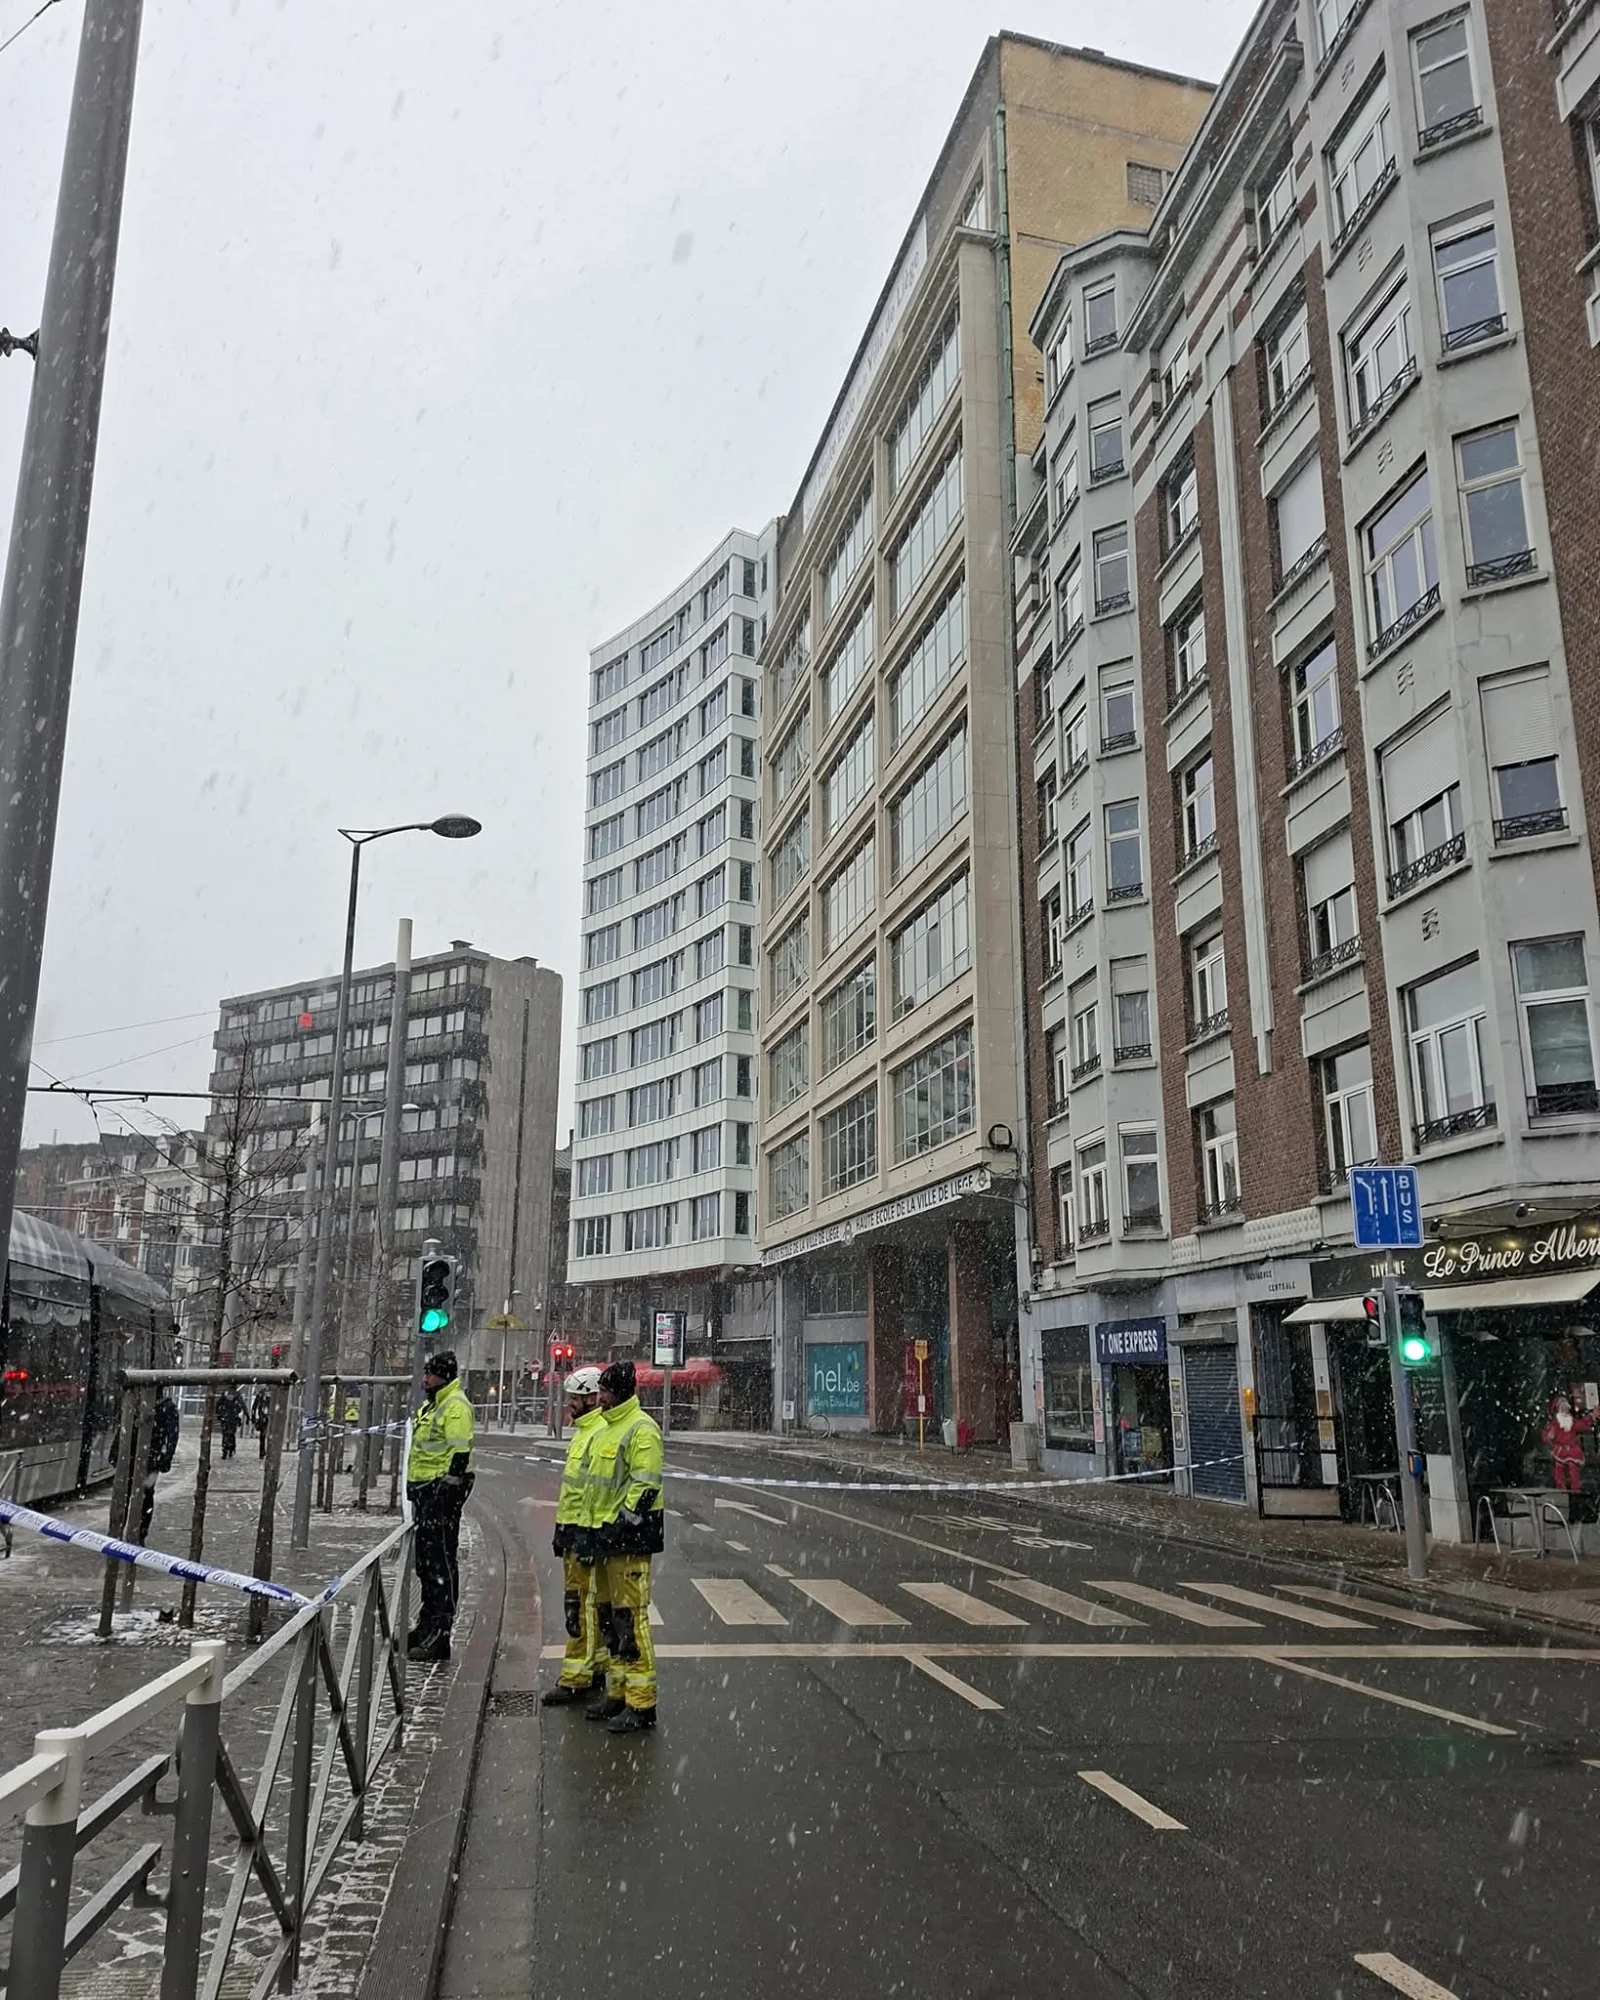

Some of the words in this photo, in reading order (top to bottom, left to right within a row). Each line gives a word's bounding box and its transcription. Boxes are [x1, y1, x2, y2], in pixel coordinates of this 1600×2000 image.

[856, 1211, 874, 1229] HAUTE
[876, 1204, 895, 1225] ECOLE
[896, 1201, 905, 1217] DE
[907, 1197, 916, 1215] LA
[917, 1189, 936, 1211] VILLE
[939, 1185, 949, 1200] DE
[1398, 1175, 1413, 1224] BUS
[1370, 1260, 1406, 1279] TAVENE
[1423, 1245, 1457, 1278] Le
[1460, 1241, 1525, 1274] Prince
[1529, 1224, 1600, 1264] Alber
[1100, 1333, 1106, 1355] 7
[1107, 1332, 1124, 1354] ONE
[1124, 1328, 1158, 1353] EXPRESS
[814, 1362, 860, 1393] hel.be
